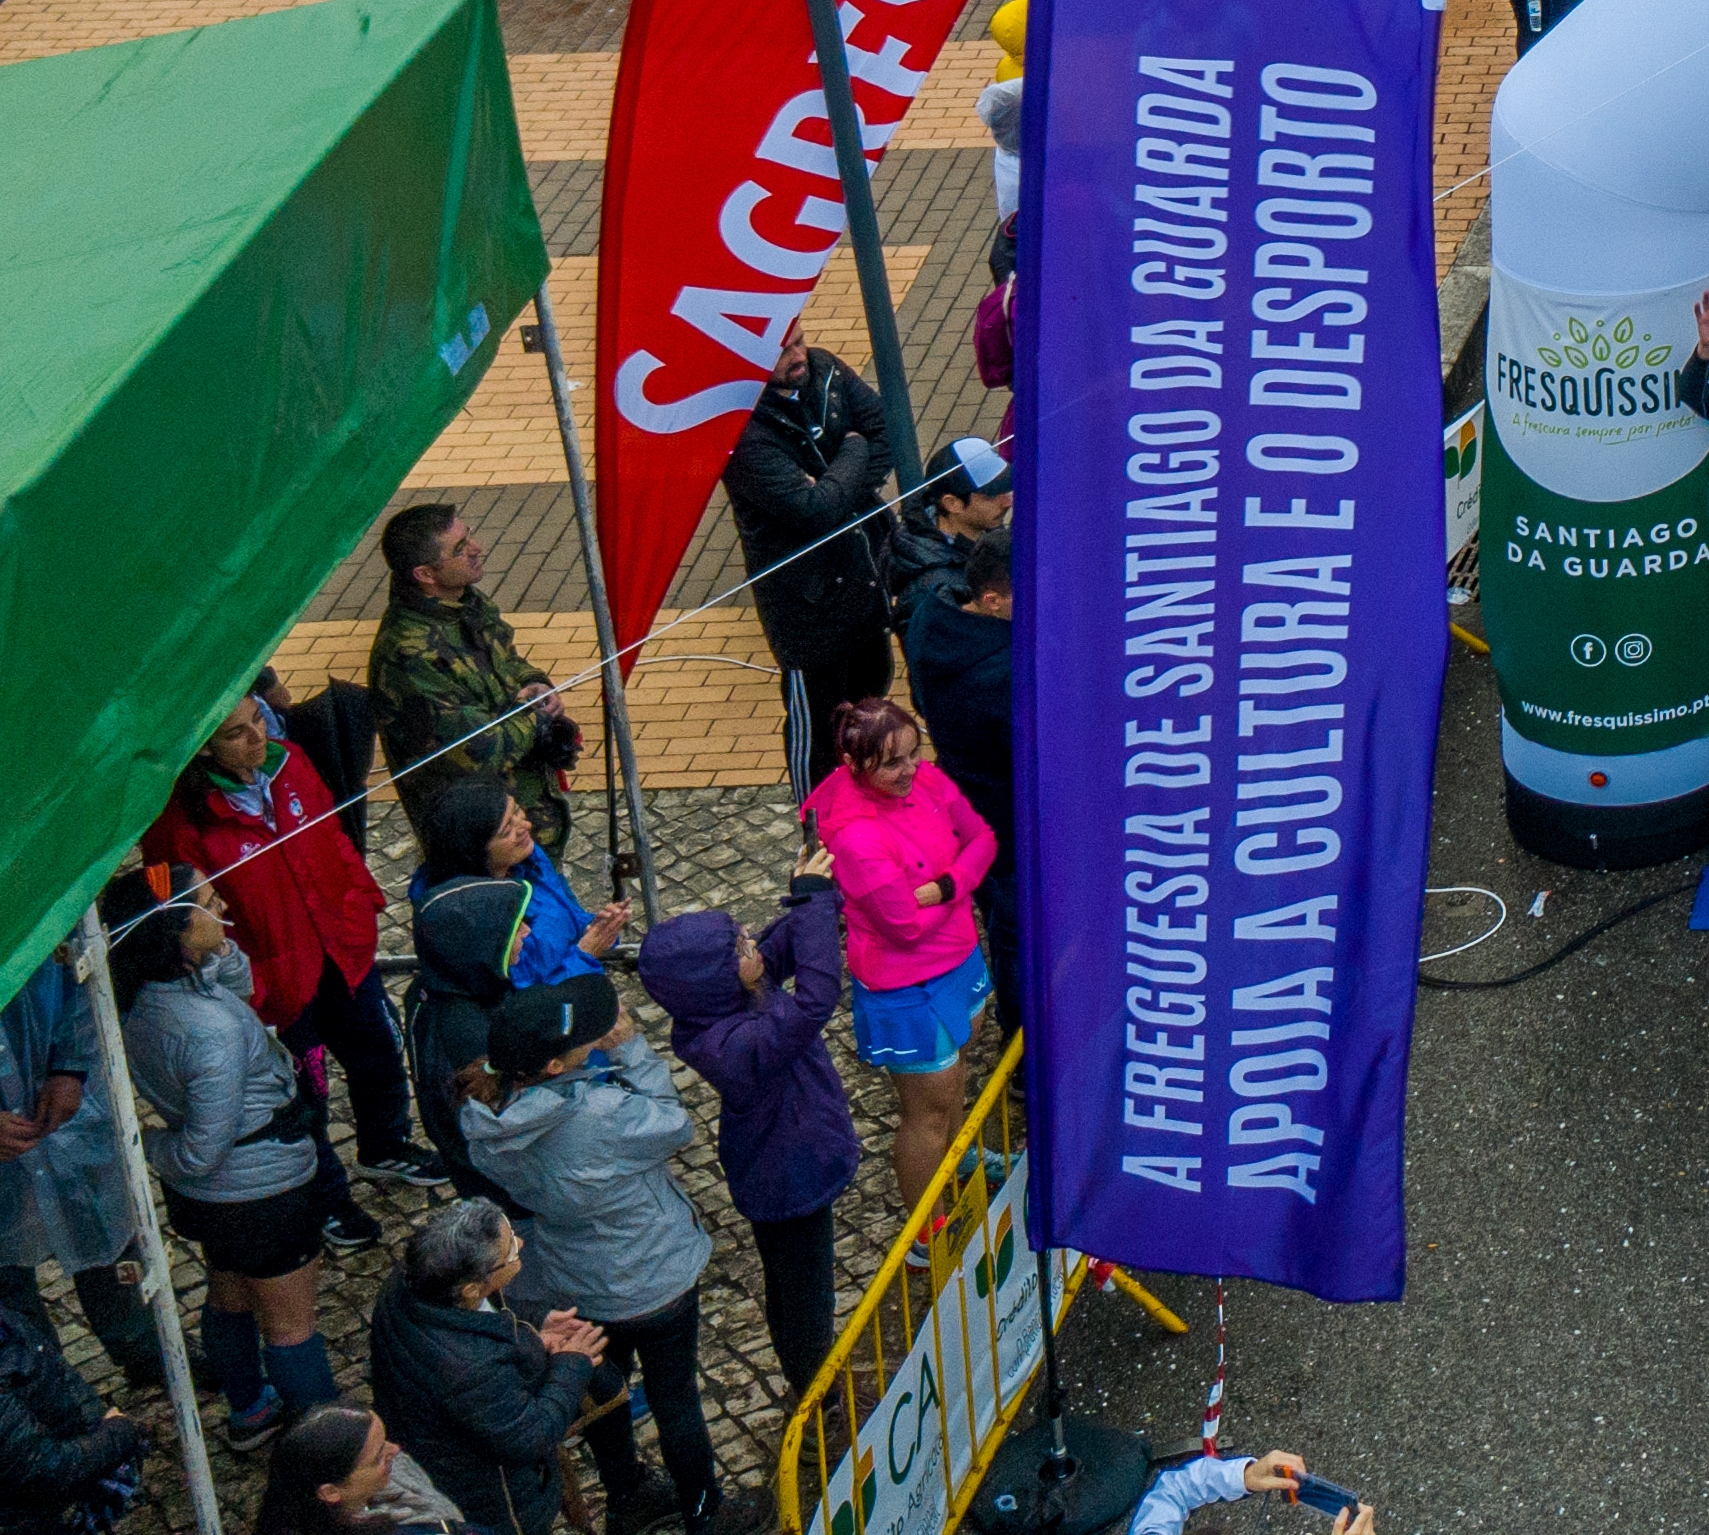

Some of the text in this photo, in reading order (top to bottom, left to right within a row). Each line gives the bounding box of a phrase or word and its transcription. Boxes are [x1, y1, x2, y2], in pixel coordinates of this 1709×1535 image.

[1523, 419, 1572, 437] frescura
[1574, 426, 1621, 444] sempre
[1627, 425, 1652, 441] por
[1506, 541, 1547, 572] DA
[1515, 516, 1699, 550] SANTIAGO
[1121, 55, 1236, 1193] A FREGUESIA DE SANTIAGO DA GUARDA
[1225, 59, 1380, 1205] APOIA A CULTURA E O DESPORTO
[996, 1270, 1041, 1340] Crédito
[889, 1350, 944, 1487] CA
